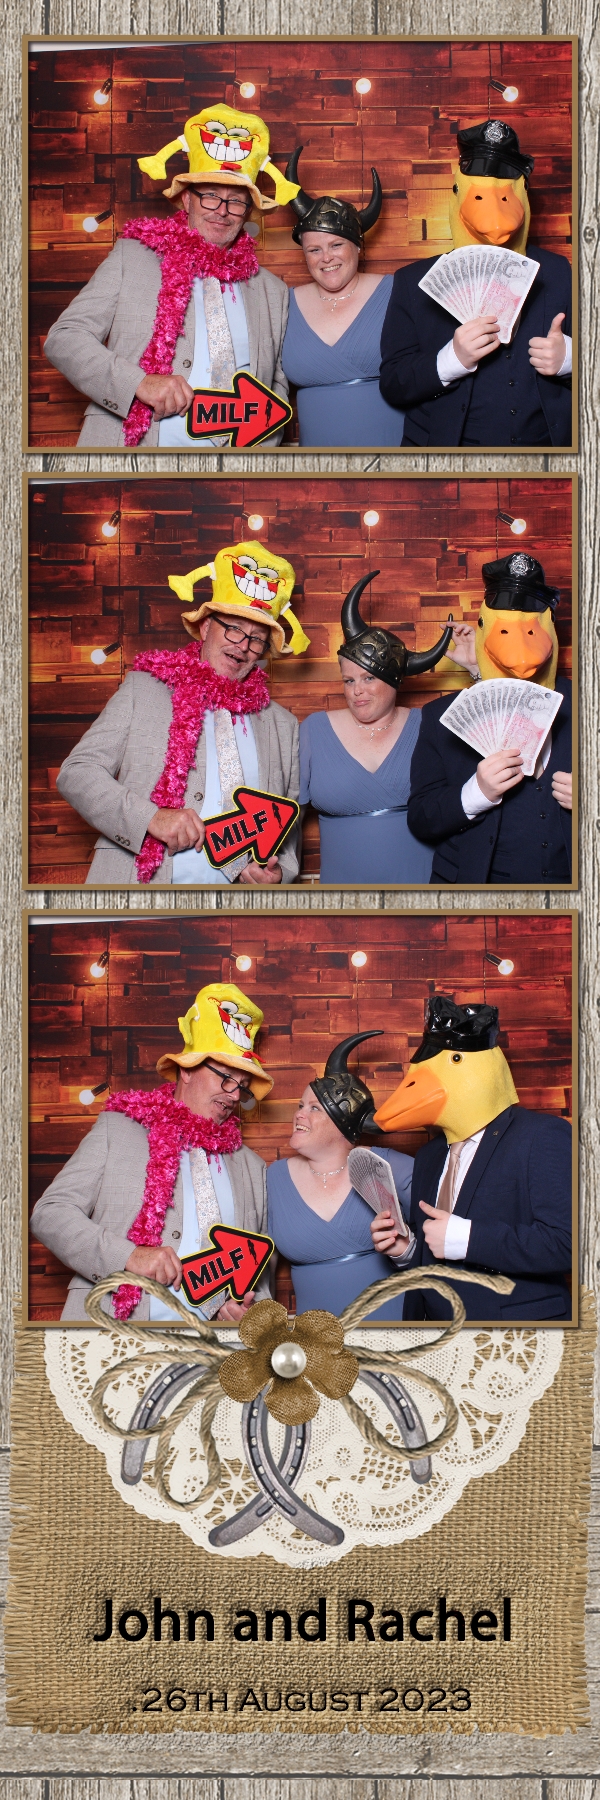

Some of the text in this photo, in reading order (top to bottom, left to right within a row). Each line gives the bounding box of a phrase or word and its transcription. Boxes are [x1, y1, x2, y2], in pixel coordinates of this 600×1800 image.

[195, 401, 259, 425] MILF
[209, 810, 269, 853] MILF
[187, 1247, 246, 1291] MILF
